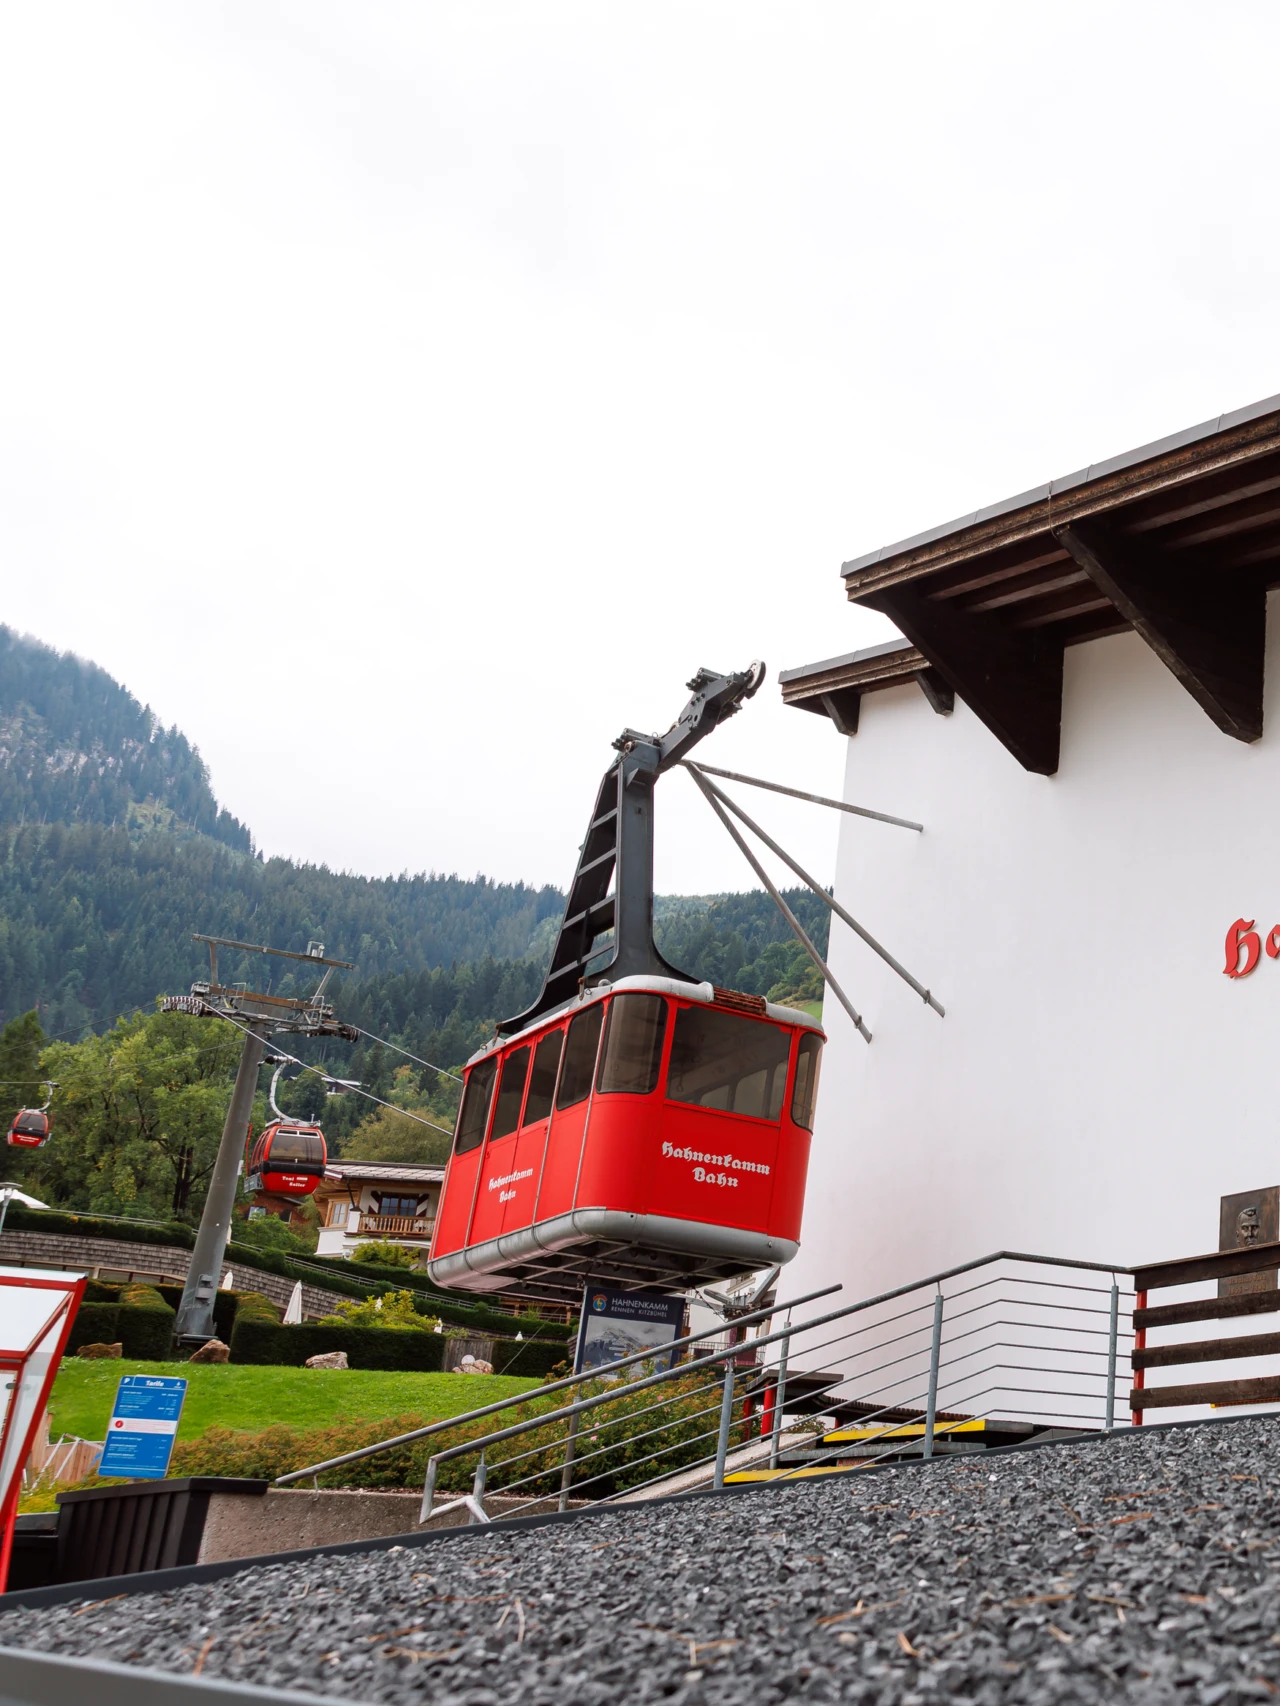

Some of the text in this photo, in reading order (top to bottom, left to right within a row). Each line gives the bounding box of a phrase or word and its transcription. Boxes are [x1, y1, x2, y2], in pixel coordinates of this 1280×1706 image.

[662, 1141, 770, 1175] Hahnenkamm
[692, 1167, 738, 1187] Bahn
[610, 1306, 635, 1314] RENNEN
[611, 1298, 669, 1311] HAHNENKAMM
